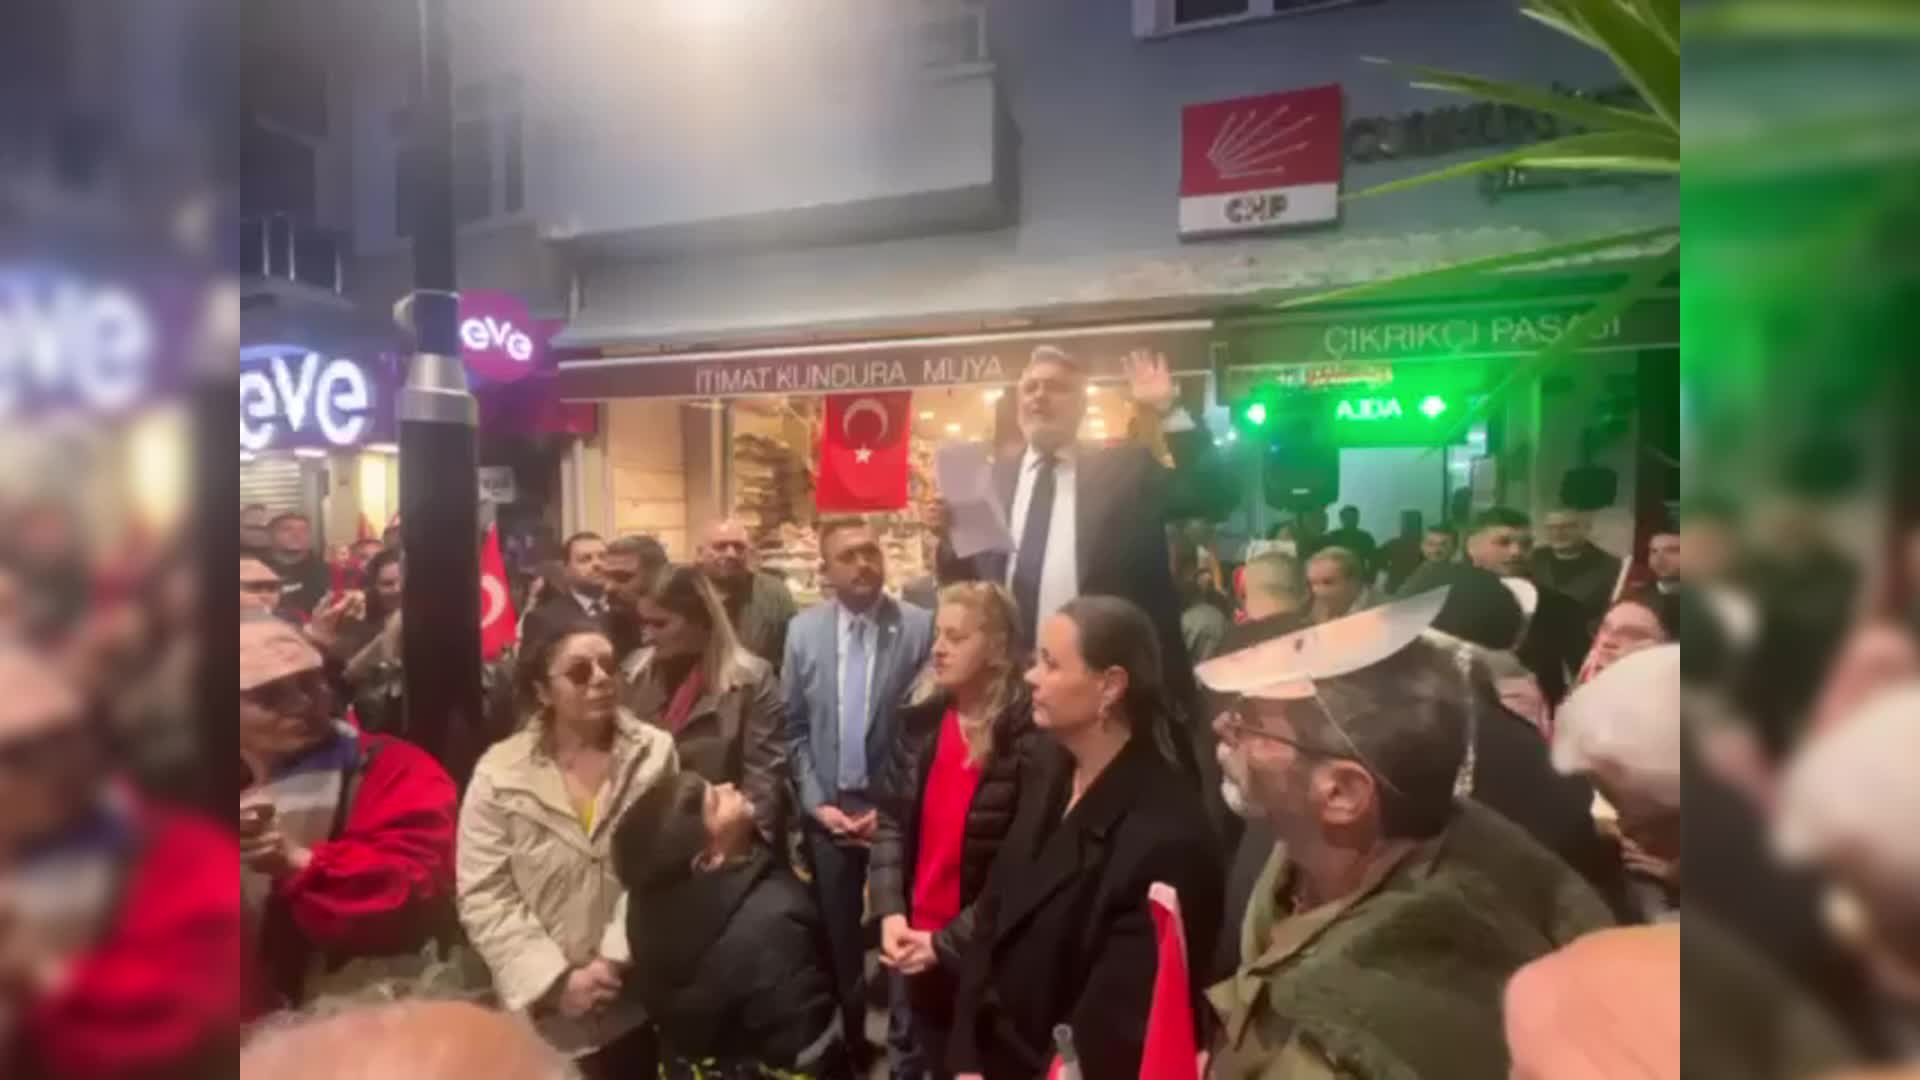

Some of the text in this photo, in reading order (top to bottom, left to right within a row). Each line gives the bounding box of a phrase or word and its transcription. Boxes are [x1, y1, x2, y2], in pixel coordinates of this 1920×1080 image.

[1223, 193, 1289, 225] CHP
[460, 315, 533, 361] eve
[775, 360, 907, 390] KUNDURA
[240, 352, 369, 449] eve
